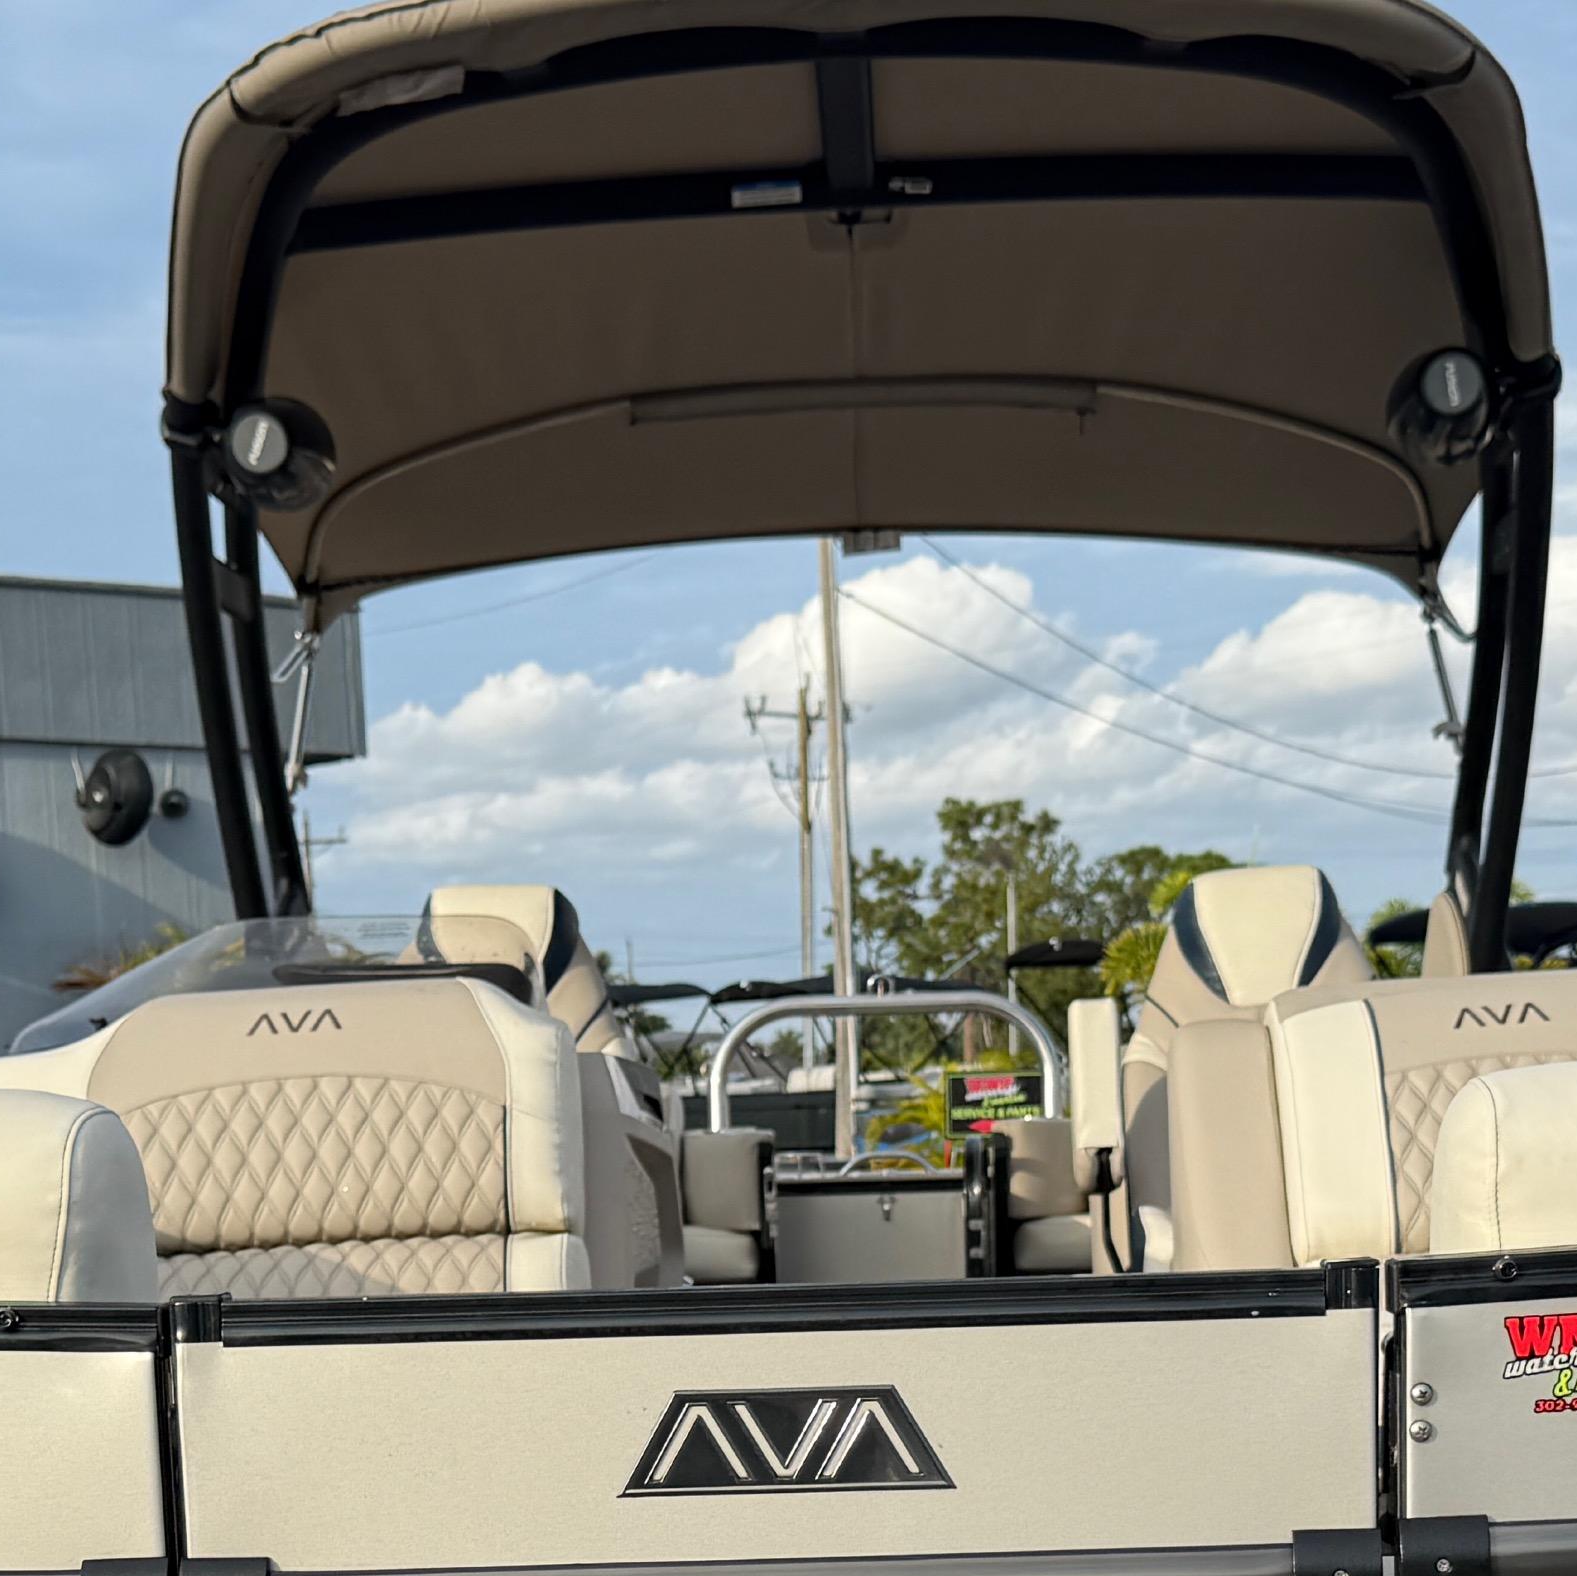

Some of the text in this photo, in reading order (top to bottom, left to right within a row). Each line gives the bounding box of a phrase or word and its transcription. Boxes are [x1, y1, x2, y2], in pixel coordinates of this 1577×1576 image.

[246, 1007, 343, 1037] AVA
[1453, 1001, 1551, 1030] AVA
[1553, 1367, 1573, 1398] &
[643, 1397, 925, 1485] AVA
